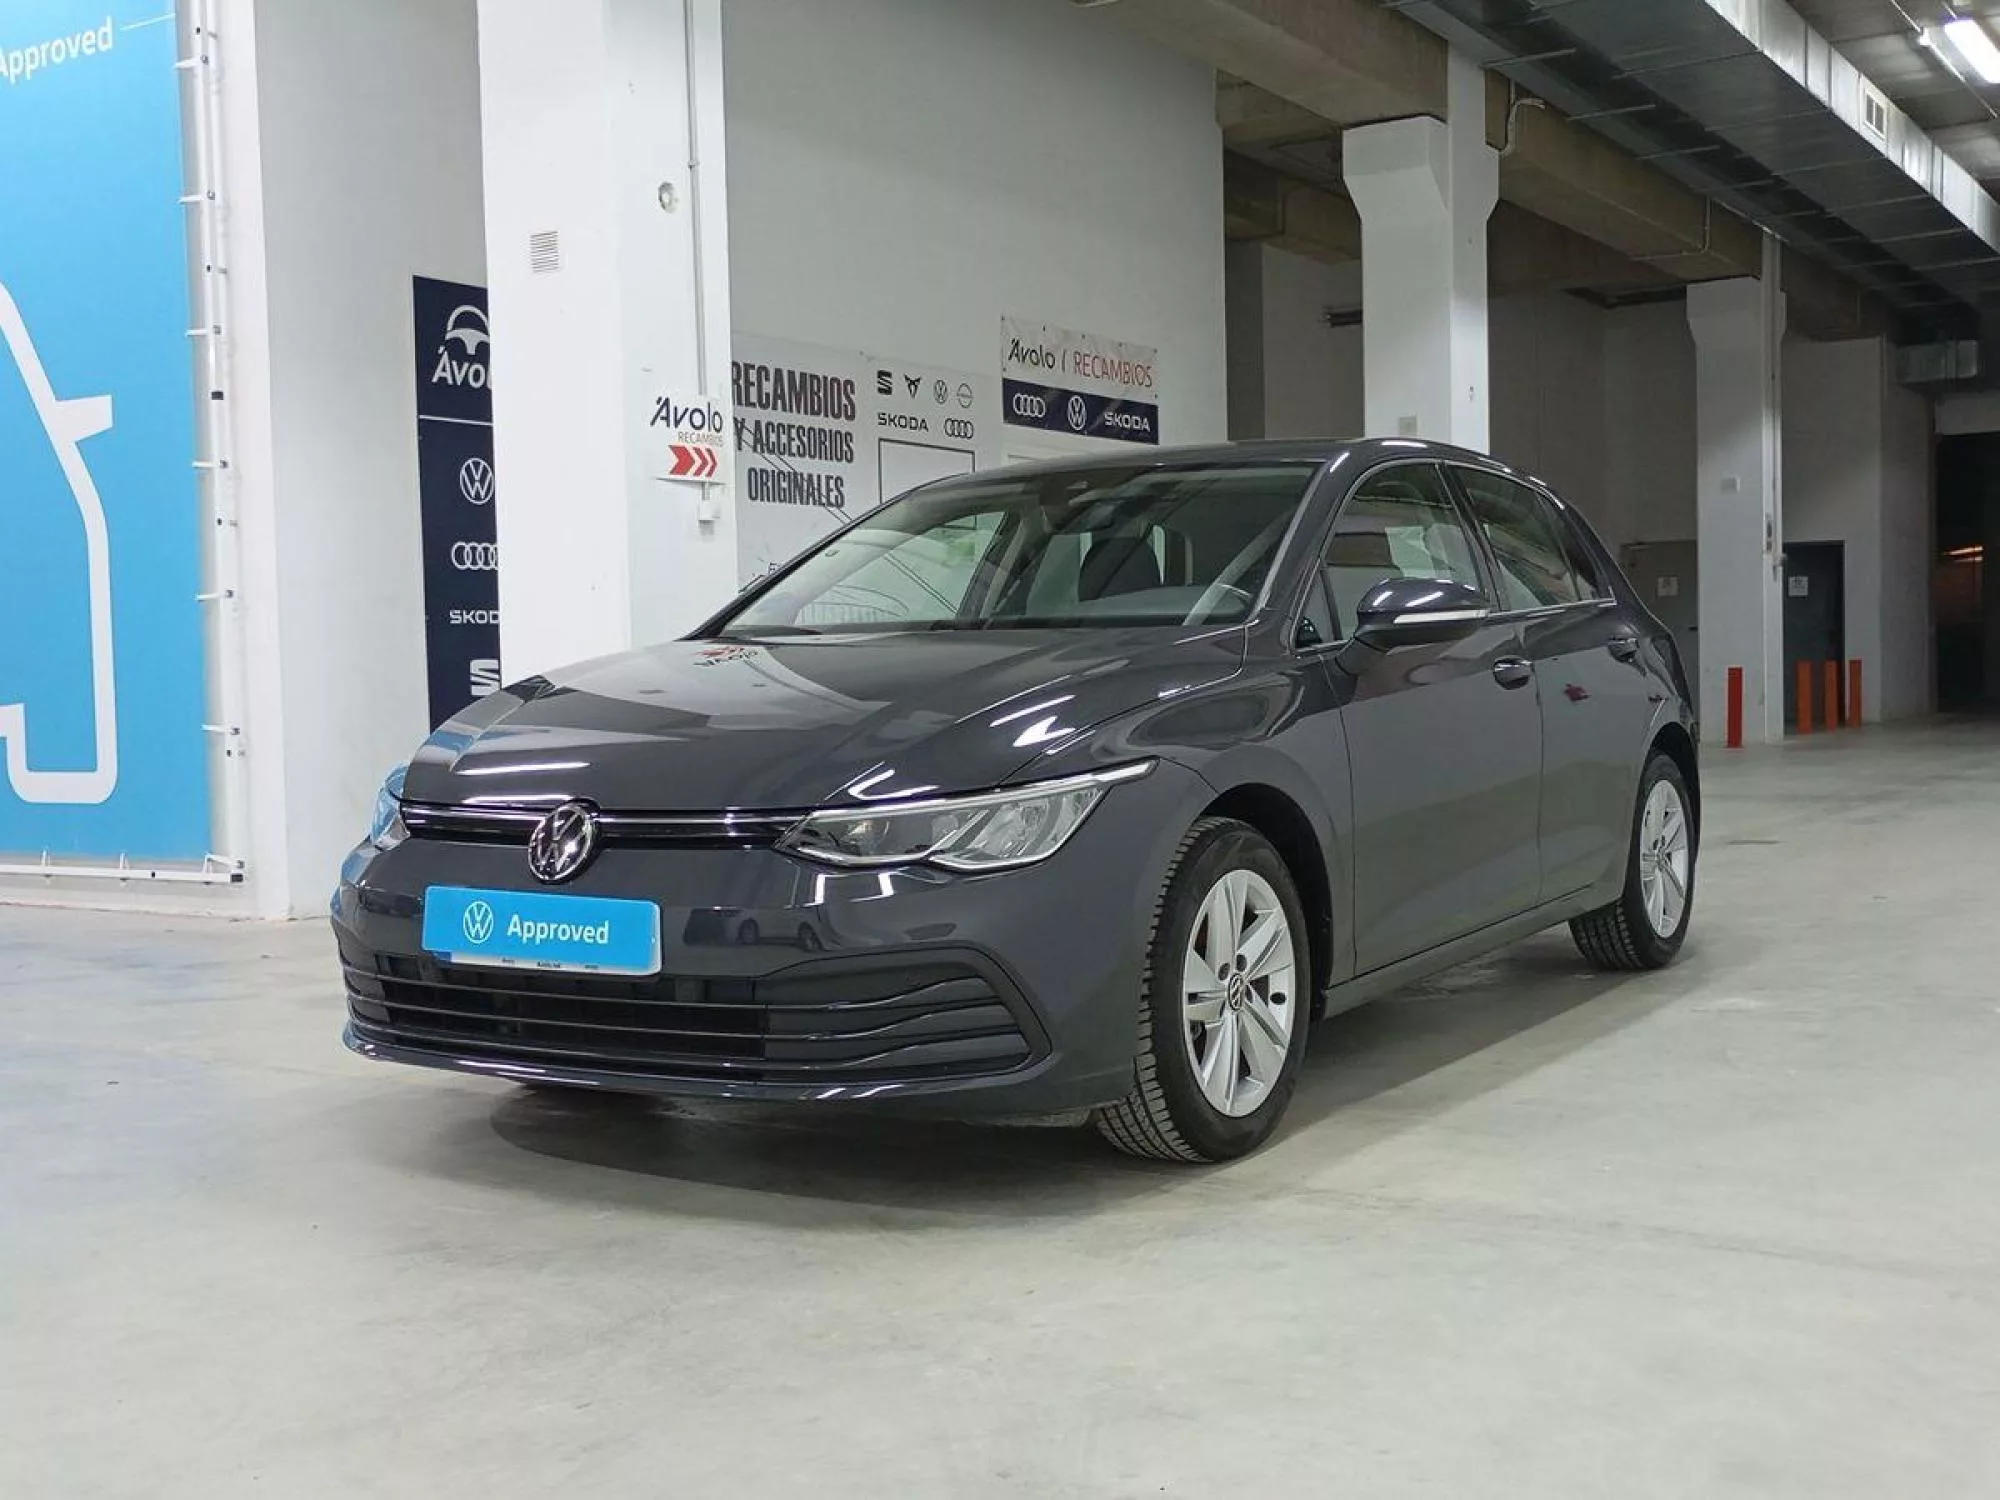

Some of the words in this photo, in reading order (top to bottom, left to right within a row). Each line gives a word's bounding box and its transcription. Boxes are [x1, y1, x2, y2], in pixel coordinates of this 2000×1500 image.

[732, 360, 856, 421] RECAMBIOS
[1072, 351, 1153, 388] RECAMBIOS
[733, 416, 746, 451] Y
[752, 419, 854, 464] ACCESORIOS
[747, 466, 845, 508] ORIGINALES
[507, 914, 609, 945] Approved
